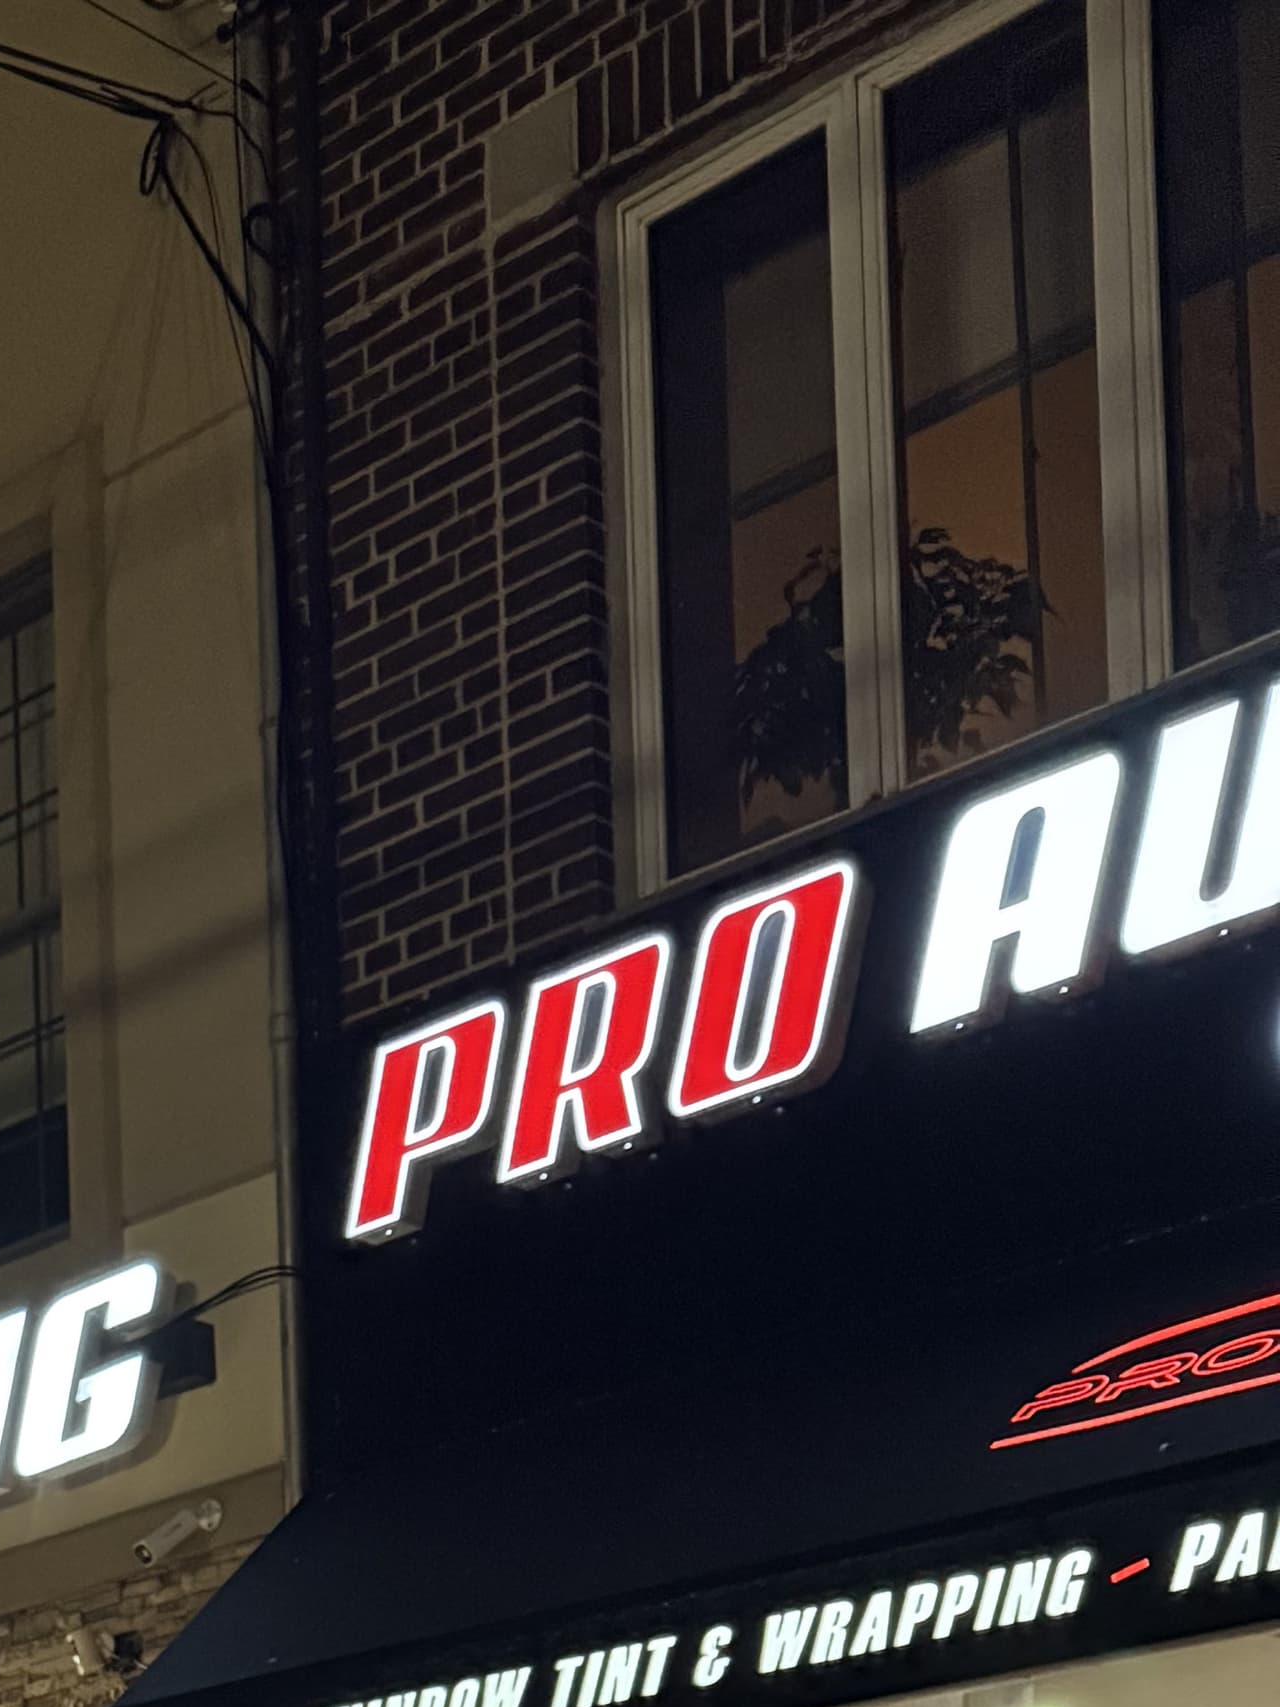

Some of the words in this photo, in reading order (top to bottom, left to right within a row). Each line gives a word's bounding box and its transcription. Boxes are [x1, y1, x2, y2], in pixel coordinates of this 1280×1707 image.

[344, 860, 857, 1241] PRO
[1009, 1329, 1280, 1423] PRO
[691, 1624, 734, 1688] &
[756, 1548, 1094, 1675] WRAPPING
